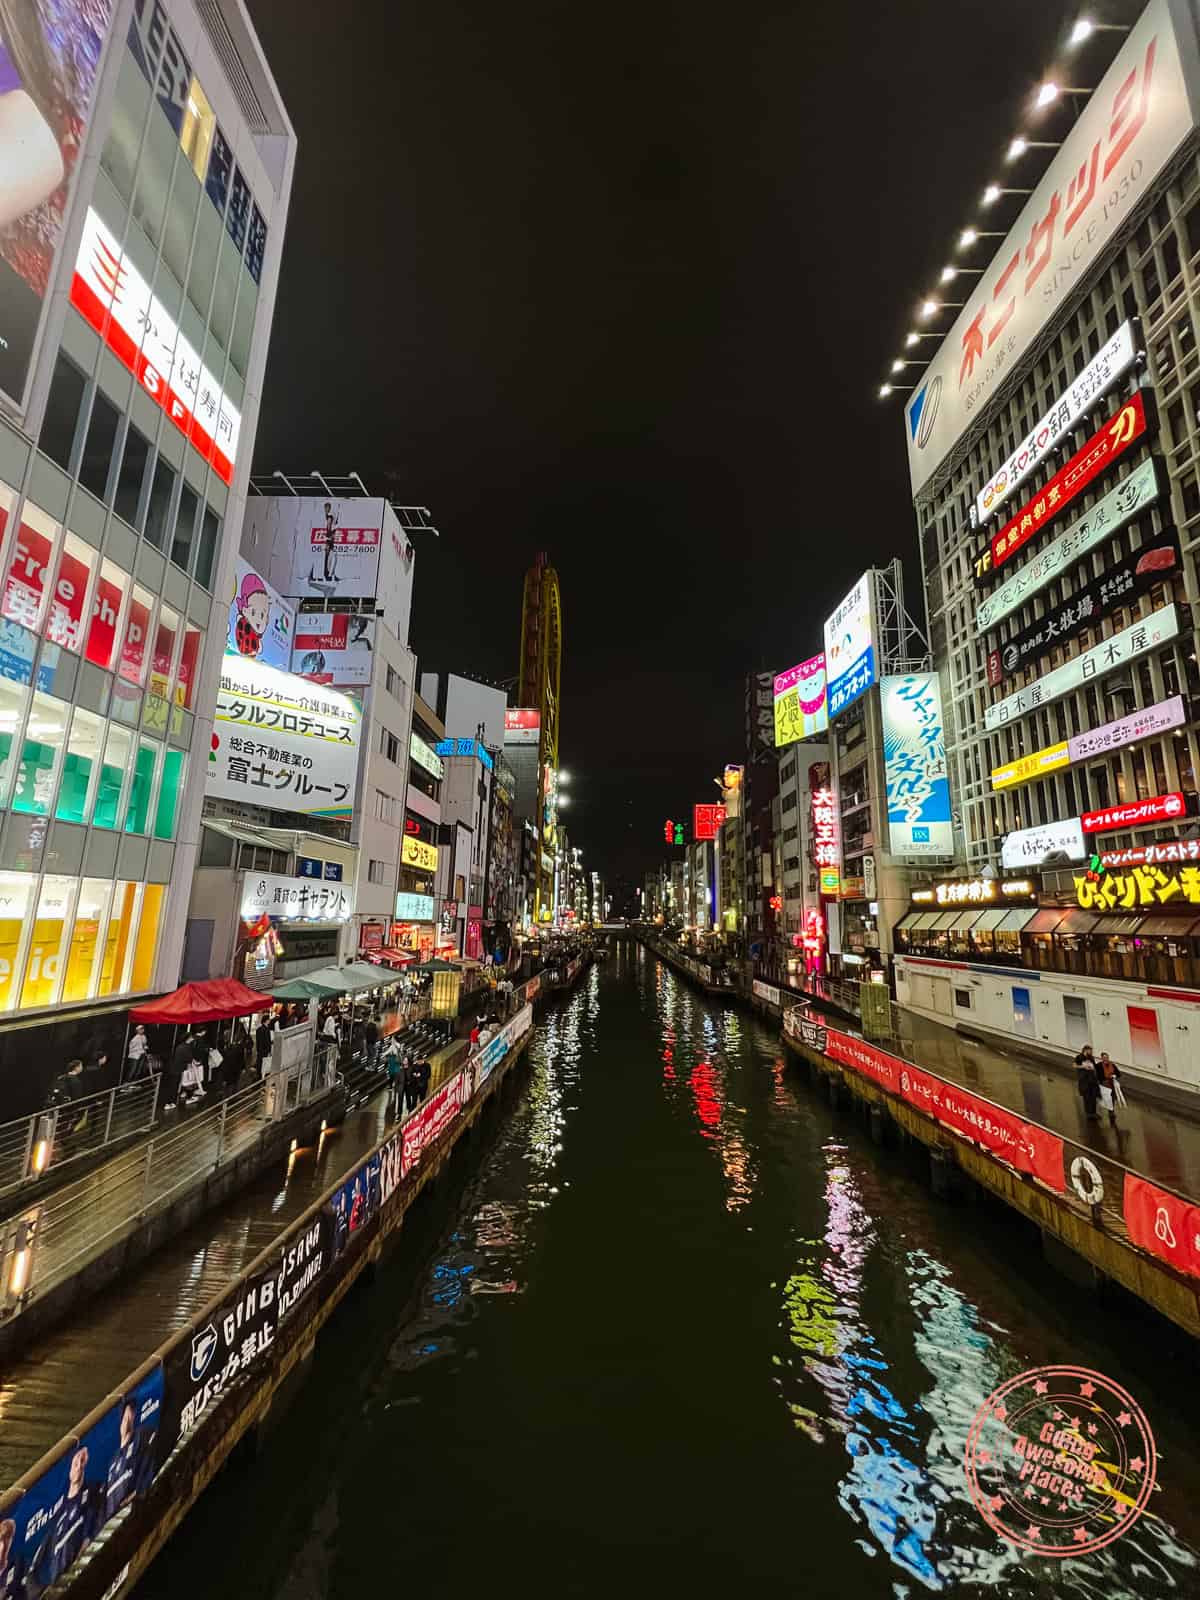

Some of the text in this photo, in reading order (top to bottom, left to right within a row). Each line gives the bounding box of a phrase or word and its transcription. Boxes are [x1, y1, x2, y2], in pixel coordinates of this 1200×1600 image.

[1043, 158, 1144, 304] SINCE 1930
[143, 362, 184, 418] 5F
[974, 550, 992, 578] 7F
[990, 655, 999, 681] 5F
[1082, 626, 1150, 680] 白木屋
[230, 736, 313, 769] 総合不動産業の
[227, 756, 350, 802] 富士グループ
[813, 787, 840, 866] 大阪王将
[1102, 839, 1200, 865] ハンバーグレストラ
[299, 884, 346, 910] ギャラント
[1073, 863, 1200, 910] びっくりドンキ
